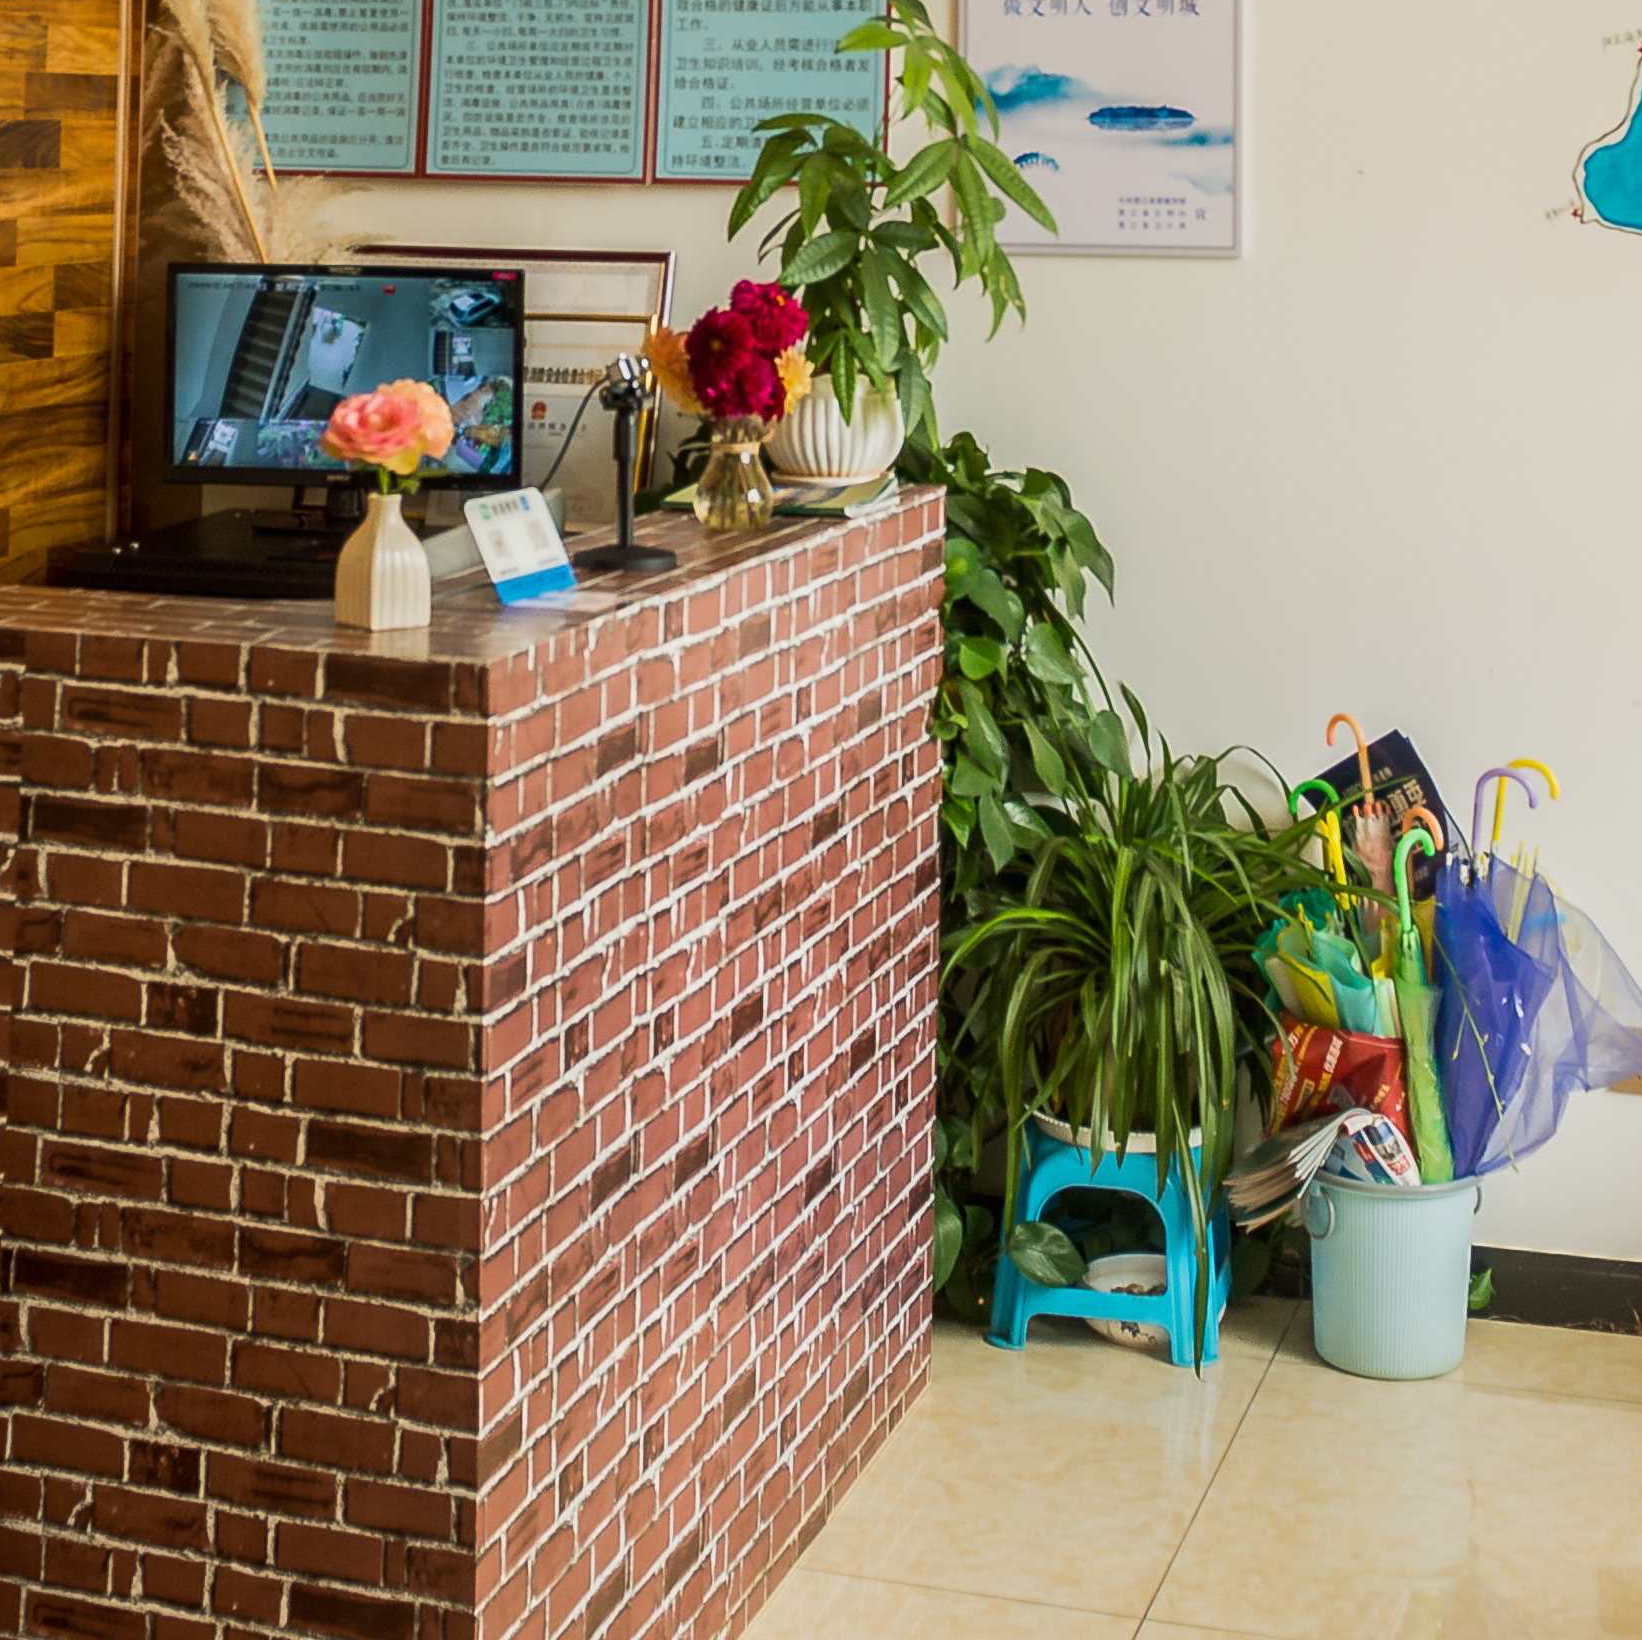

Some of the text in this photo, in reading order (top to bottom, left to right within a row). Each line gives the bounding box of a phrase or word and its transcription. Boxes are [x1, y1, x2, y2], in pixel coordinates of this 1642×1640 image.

[673, 116, 760, 130] 建立相应的卫
